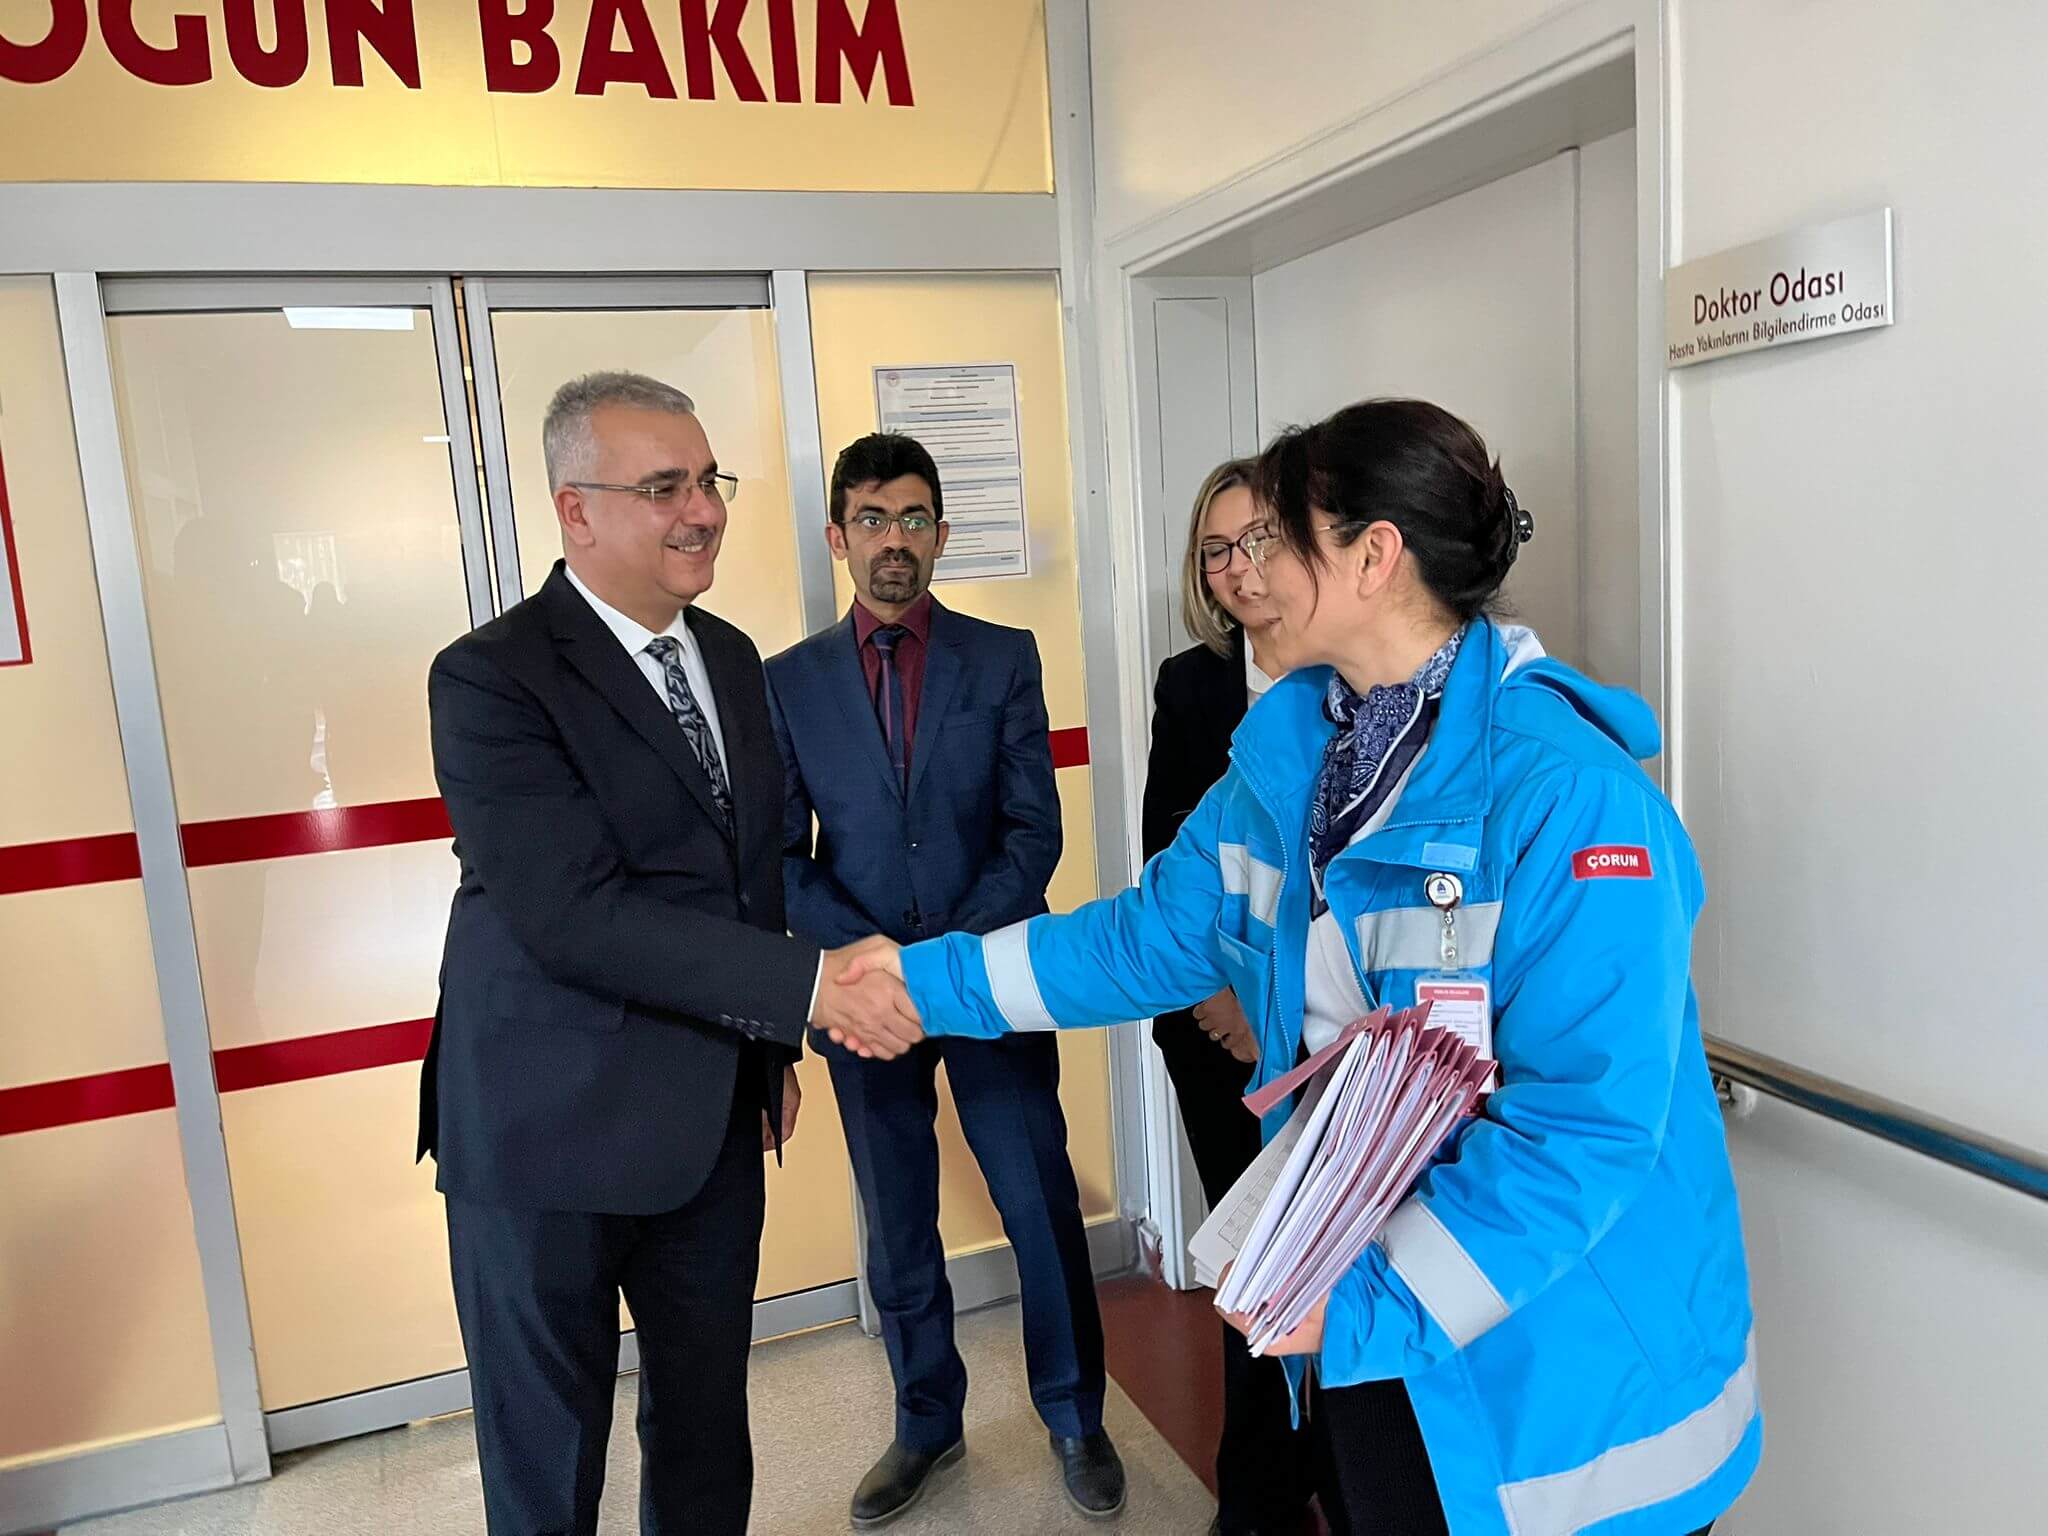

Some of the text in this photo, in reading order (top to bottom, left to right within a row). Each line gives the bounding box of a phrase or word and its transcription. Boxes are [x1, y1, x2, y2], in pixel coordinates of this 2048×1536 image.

[481, 0, 915, 107] BAKIM
[1694, 267, 1844, 325] Doktor Odası
[1668, 303, 1884, 361] Hasta Yakınlarını Bilgilendirme Odası
[1586, 854, 1639, 870] ÇORUM
